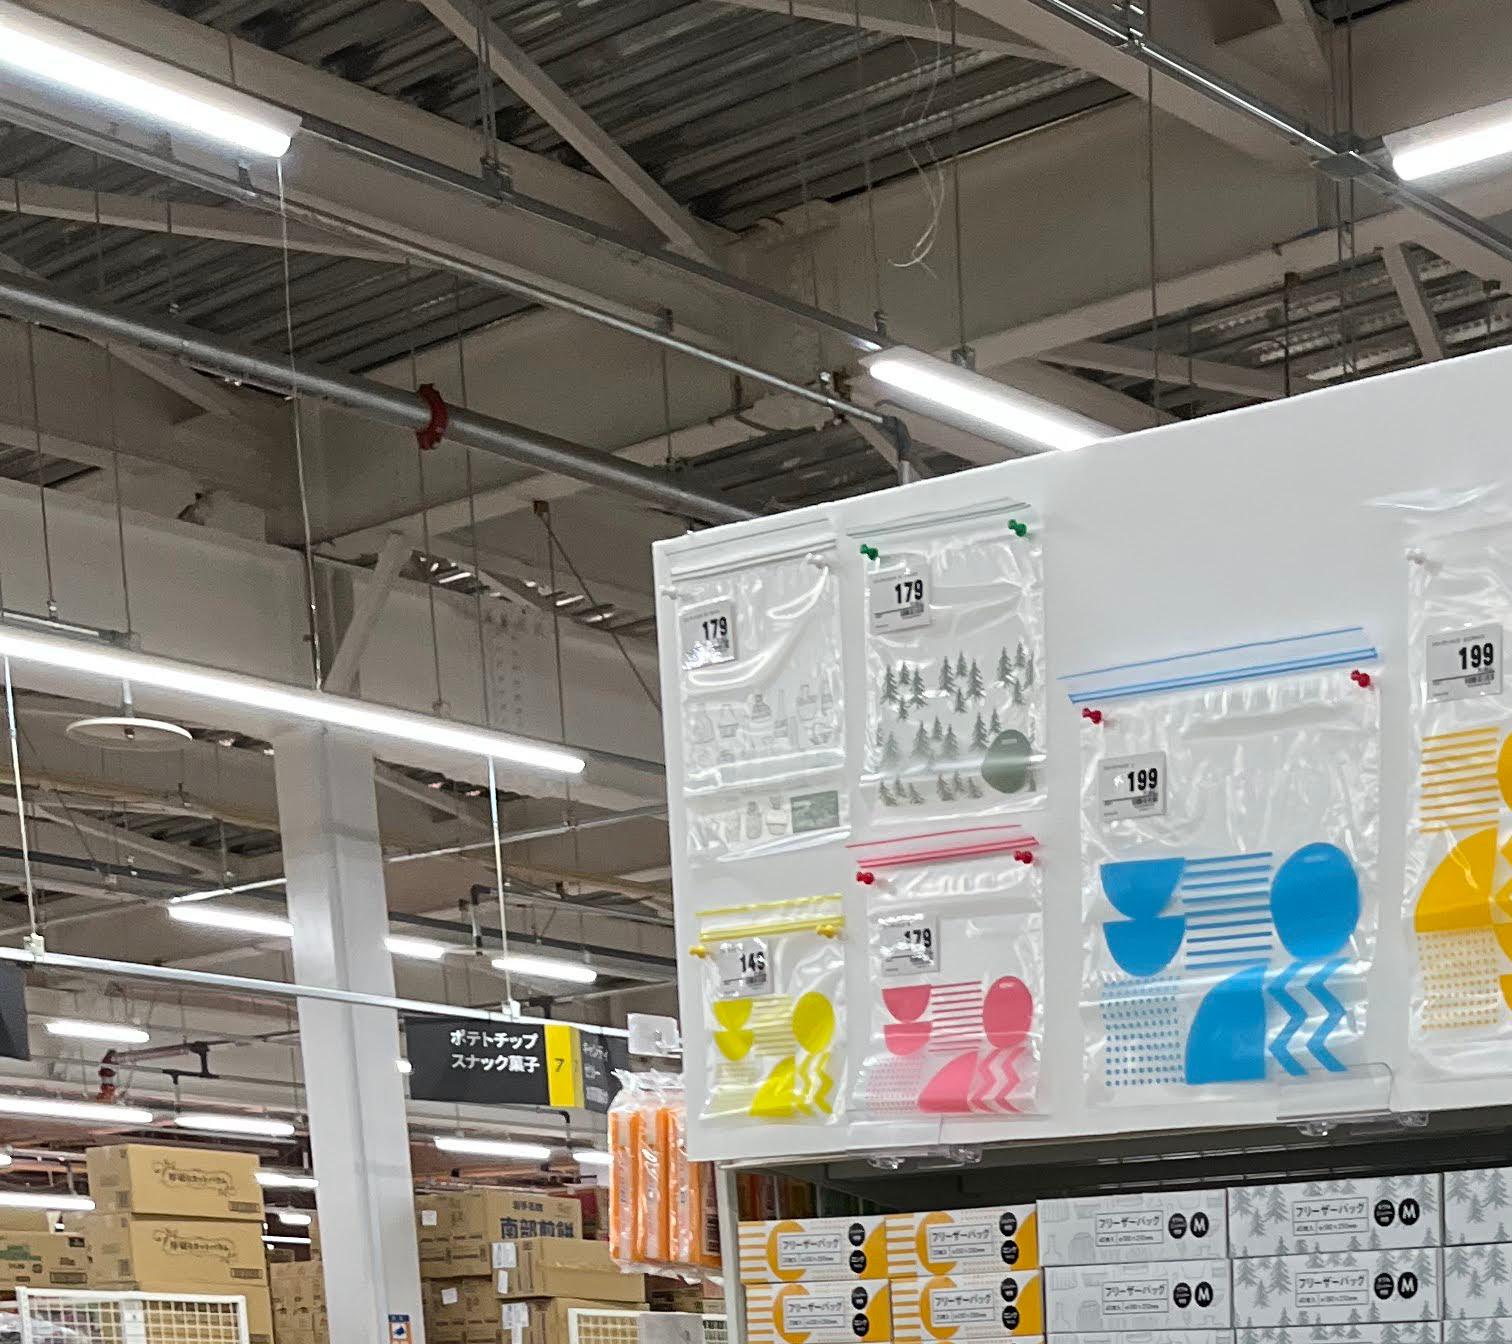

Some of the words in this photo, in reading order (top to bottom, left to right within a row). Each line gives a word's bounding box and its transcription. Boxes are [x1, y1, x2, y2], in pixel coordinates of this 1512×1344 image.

[895, 579, 924, 604] 179
[702, 616, 728, 640] 179
[1458, 642, 1494, 671] 199
[1127, 767, 1159, 792] 199
[450, 1029, 539, 1050] ポテトチップ
[451, 1053, 541, 1074] スナック菓子
[554, 1058, 565, 1072] 7
[1402, 1204, 1416, 1219] M
[1192, 1217, 1206, 1233] M
[1197, 1287, 1211, 1302] M
[1400, 1278, 1414, 1292] M
